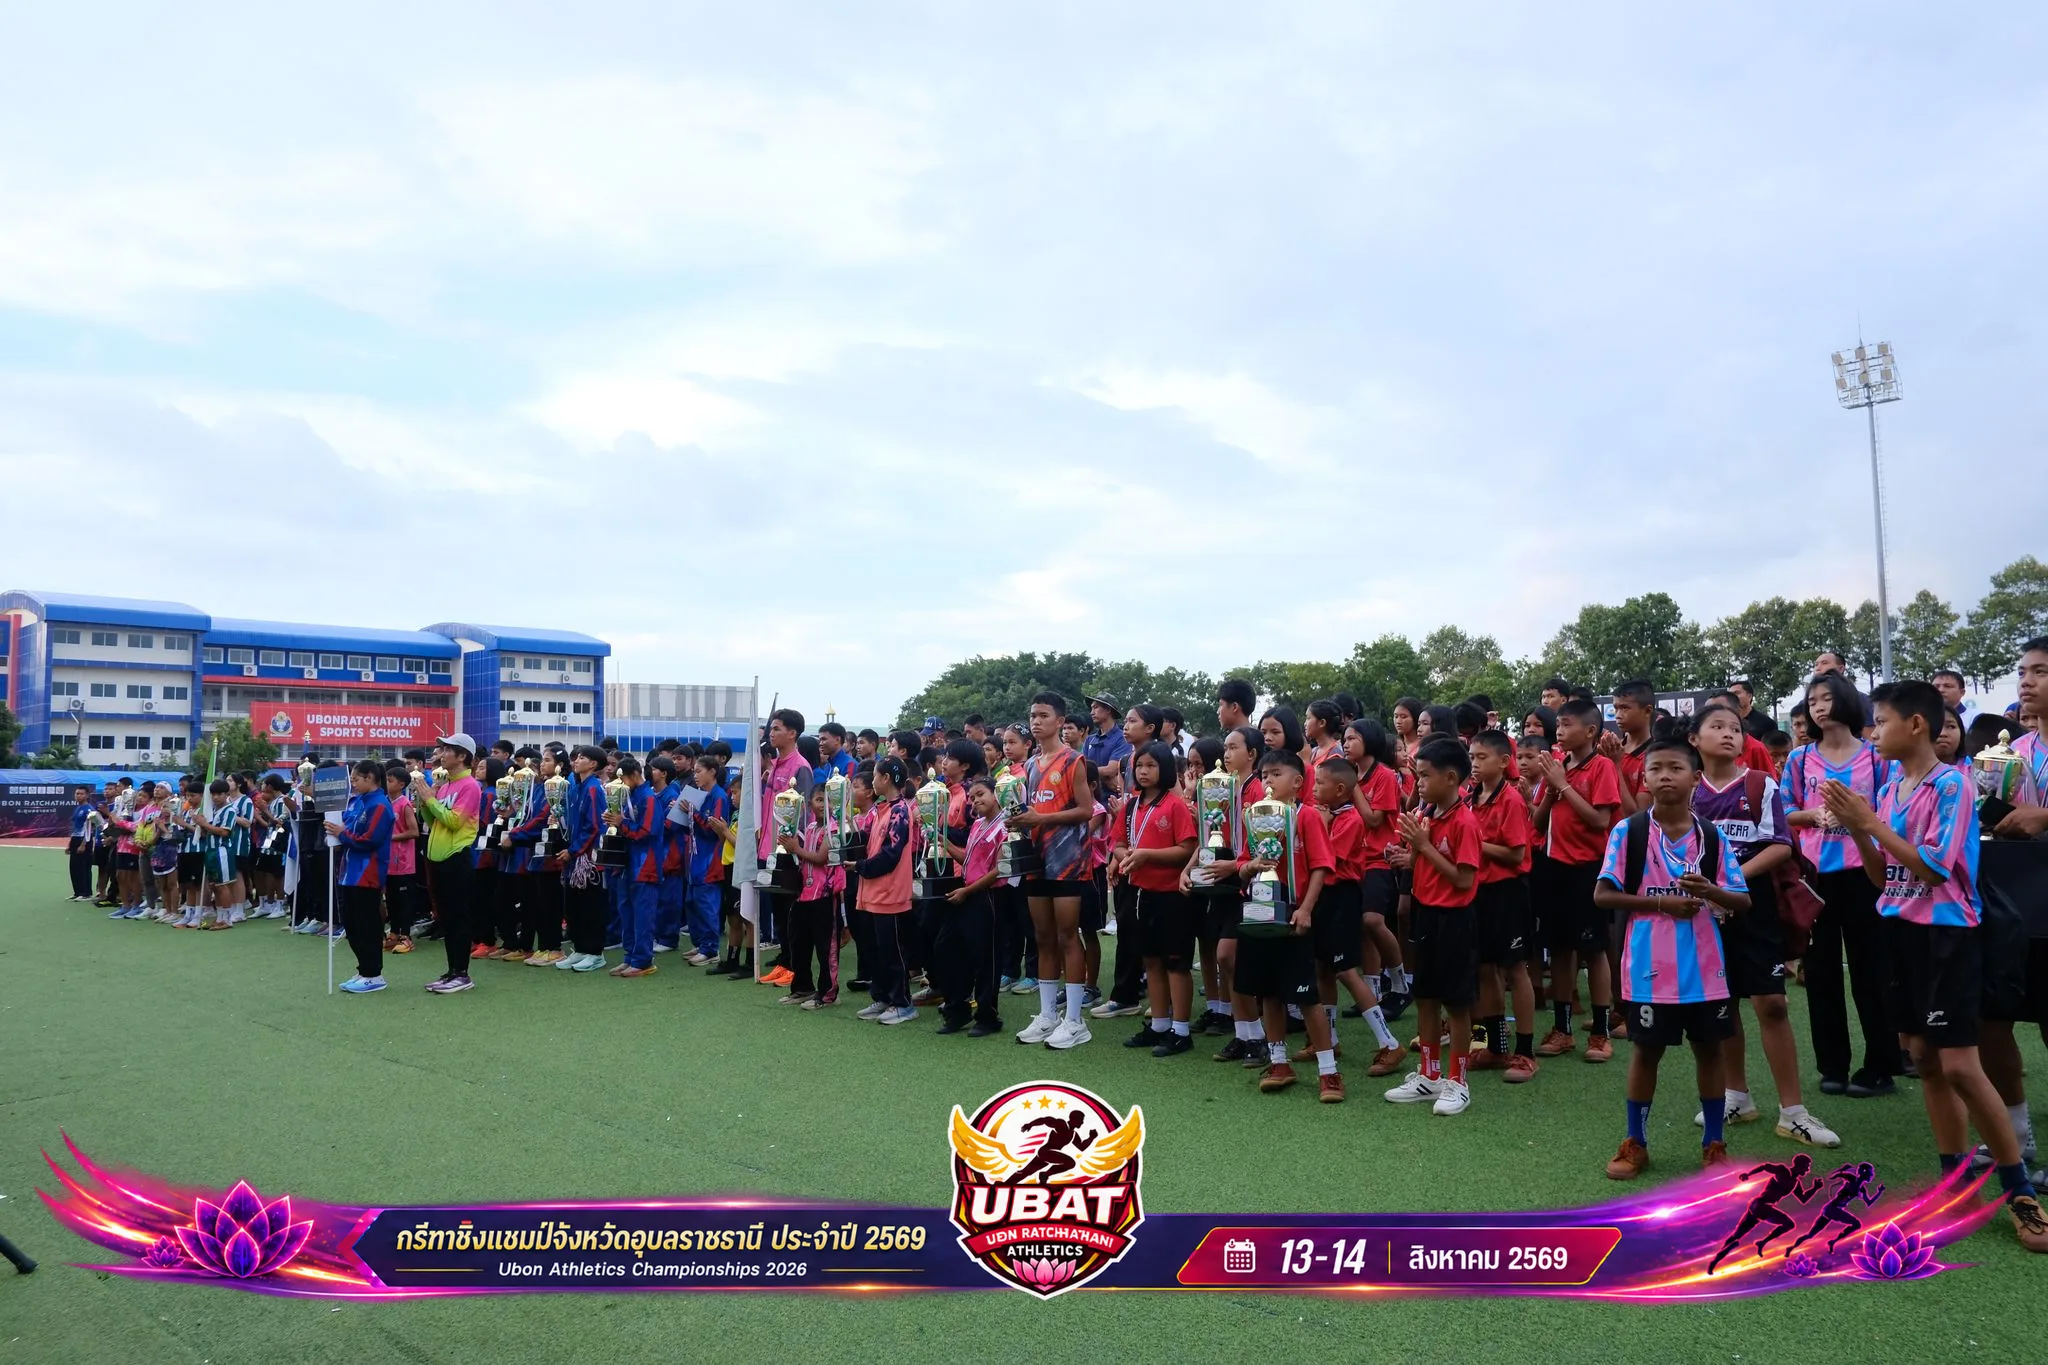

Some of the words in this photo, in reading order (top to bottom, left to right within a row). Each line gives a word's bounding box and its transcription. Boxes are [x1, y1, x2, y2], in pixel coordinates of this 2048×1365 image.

[306, 713, 421, 727] UBONRATCHATHANI
[319, 727, 364, 738] SPORTS
[369, 727, 413, 739] SCHOOL
[1639, 1004, 1655, 1028] 9
